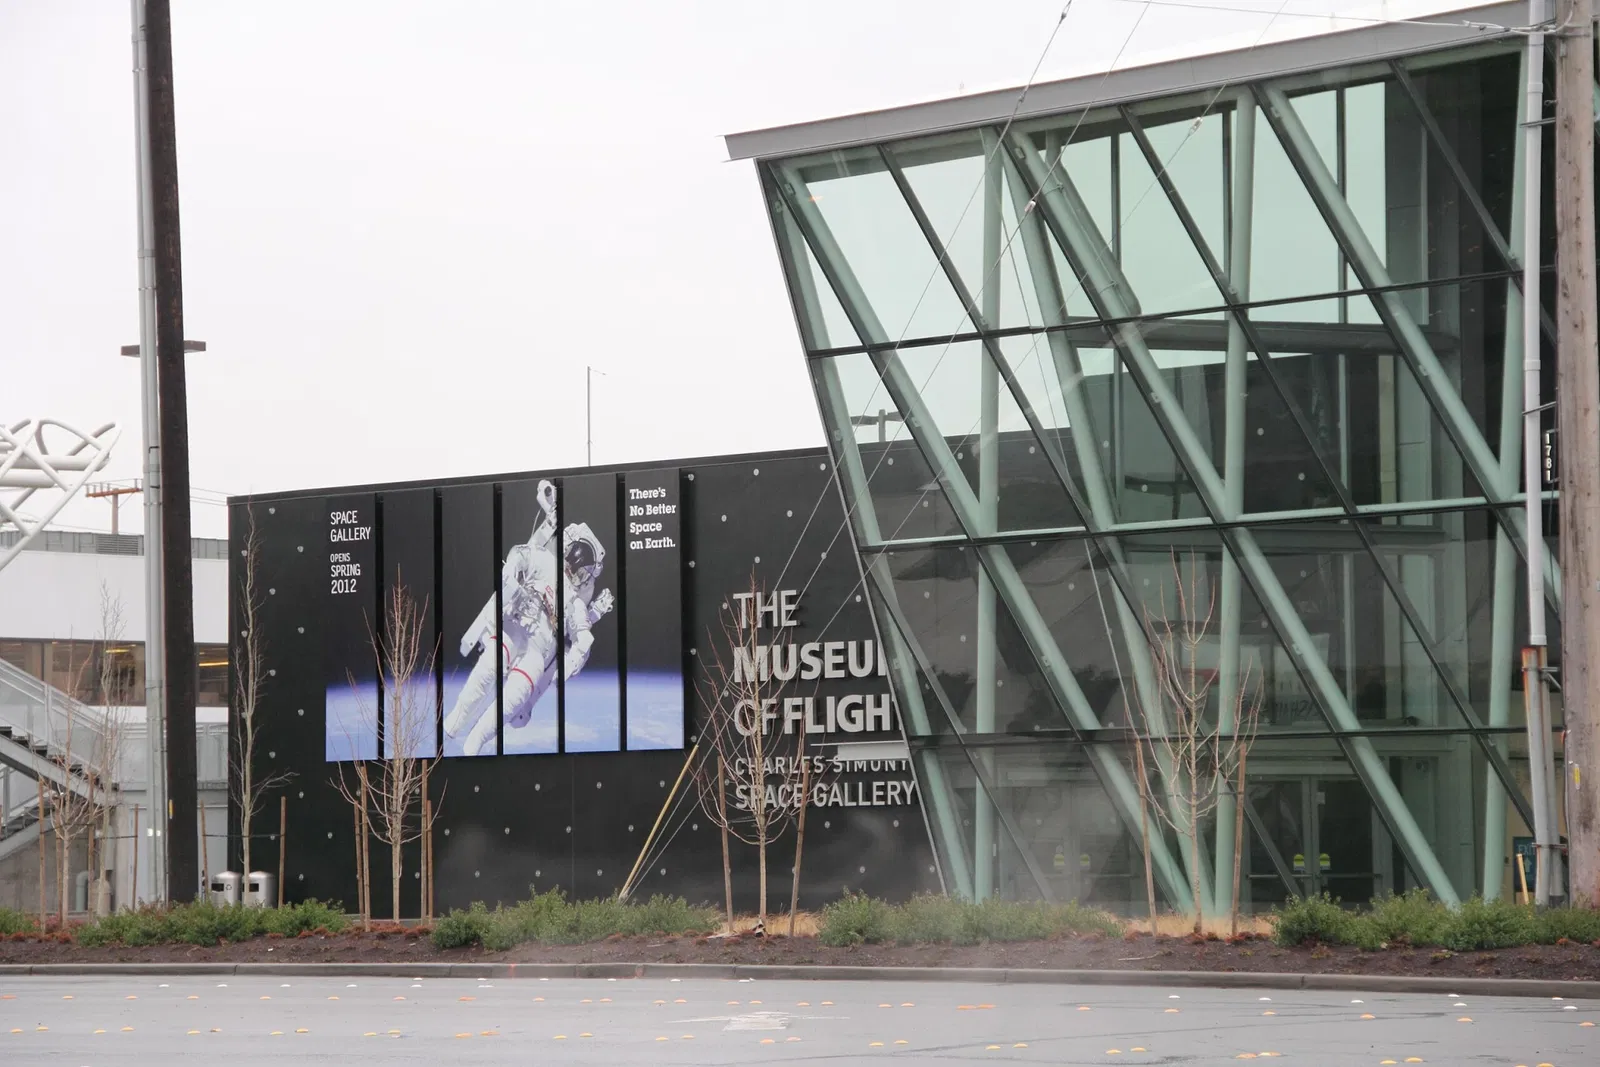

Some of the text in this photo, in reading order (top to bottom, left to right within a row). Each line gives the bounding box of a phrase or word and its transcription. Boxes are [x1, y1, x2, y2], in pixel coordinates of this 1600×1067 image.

[629, 487, 666, 500] There's
[330, 510, 358, 525] SPACE
[629, 503, 676, 517] No Better
[330, 526, 371, 542] GALLERY
[629, 522, 662, 535] Space
[630, 536, 676, 550] on Earth.
[330, 552, 351, 563] OPENS
[330, 563, 361, 577] SPRING
[331, 578, 357, 594] 2012
[733, 590, 798, 629] THE
[733, 639, 888, 683] MUSEU
[734, 693, 902, 737] OF FLIGH
[735, 755, 825, 775] CHARLES
[812, 780, 916, 807] GALLERY
